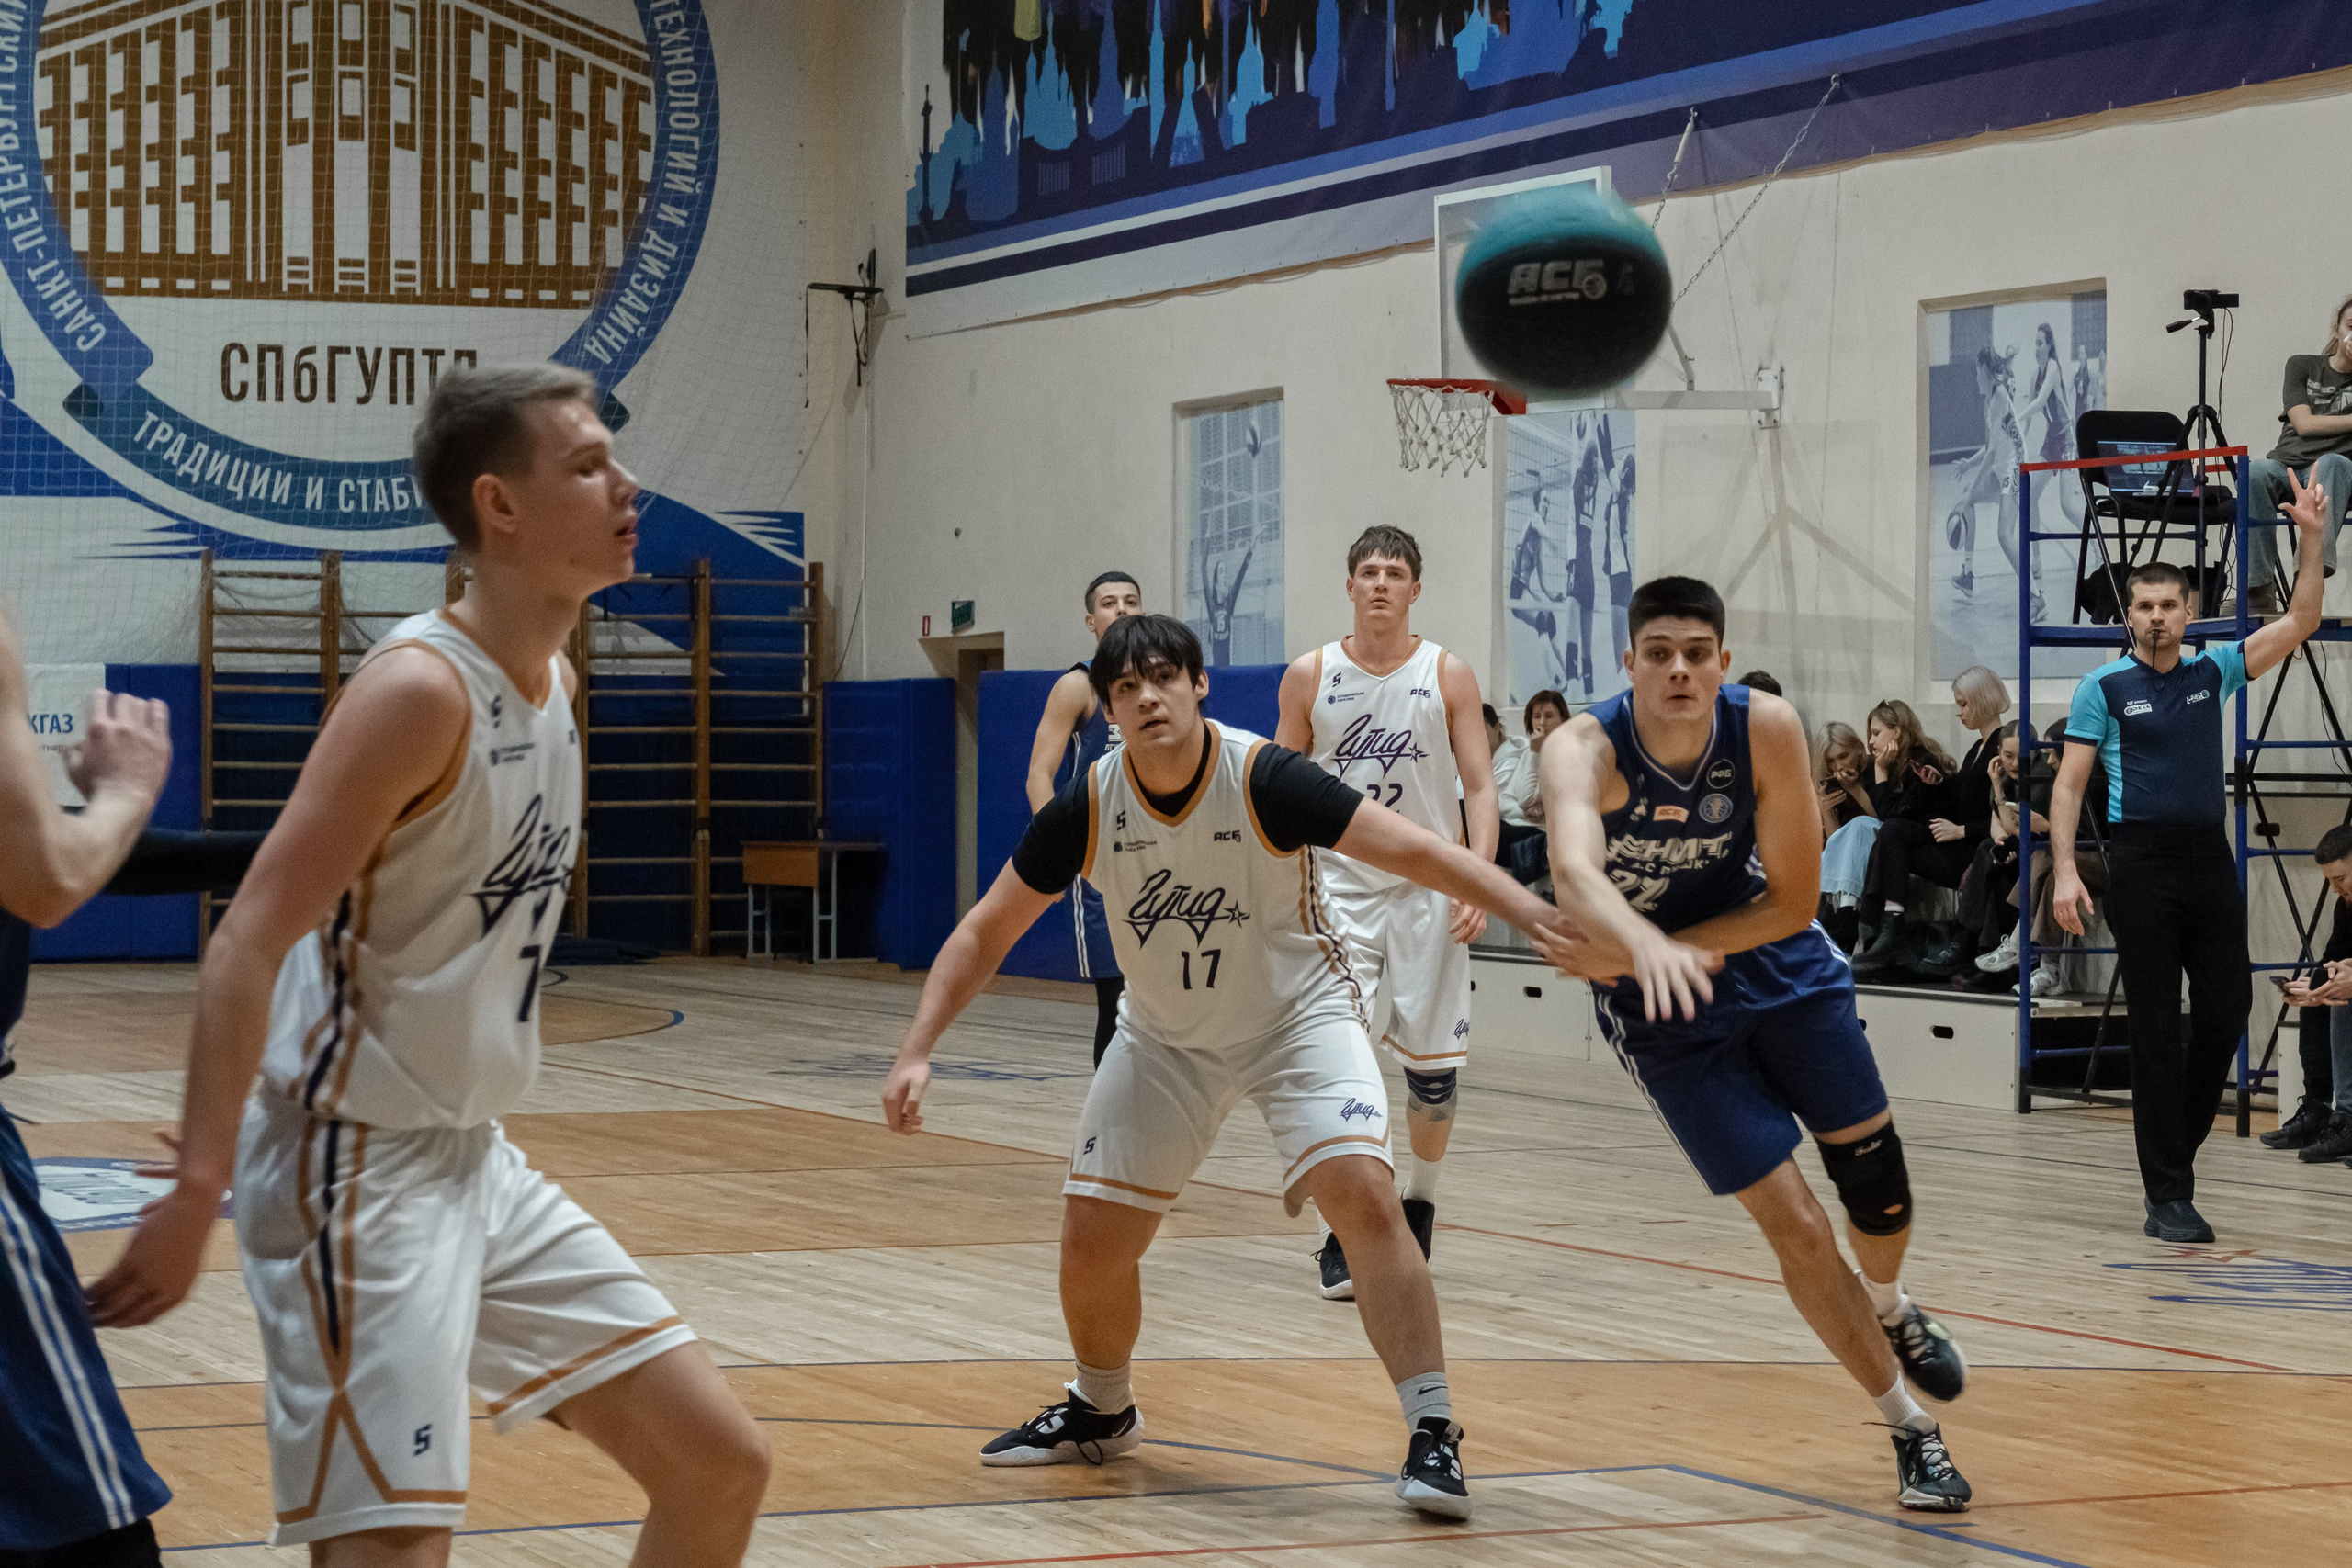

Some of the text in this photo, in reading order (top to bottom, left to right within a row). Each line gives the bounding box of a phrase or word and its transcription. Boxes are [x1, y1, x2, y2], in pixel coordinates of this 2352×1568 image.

[657, 202, 689, 228] И
[583, 228, 679, 366] ДИЗАЙНА
[133, 410, 292, 506] ТРАДИЦИИ
[304, 476, 323, 511] И
[1182, 949, 1221, 990] 17
